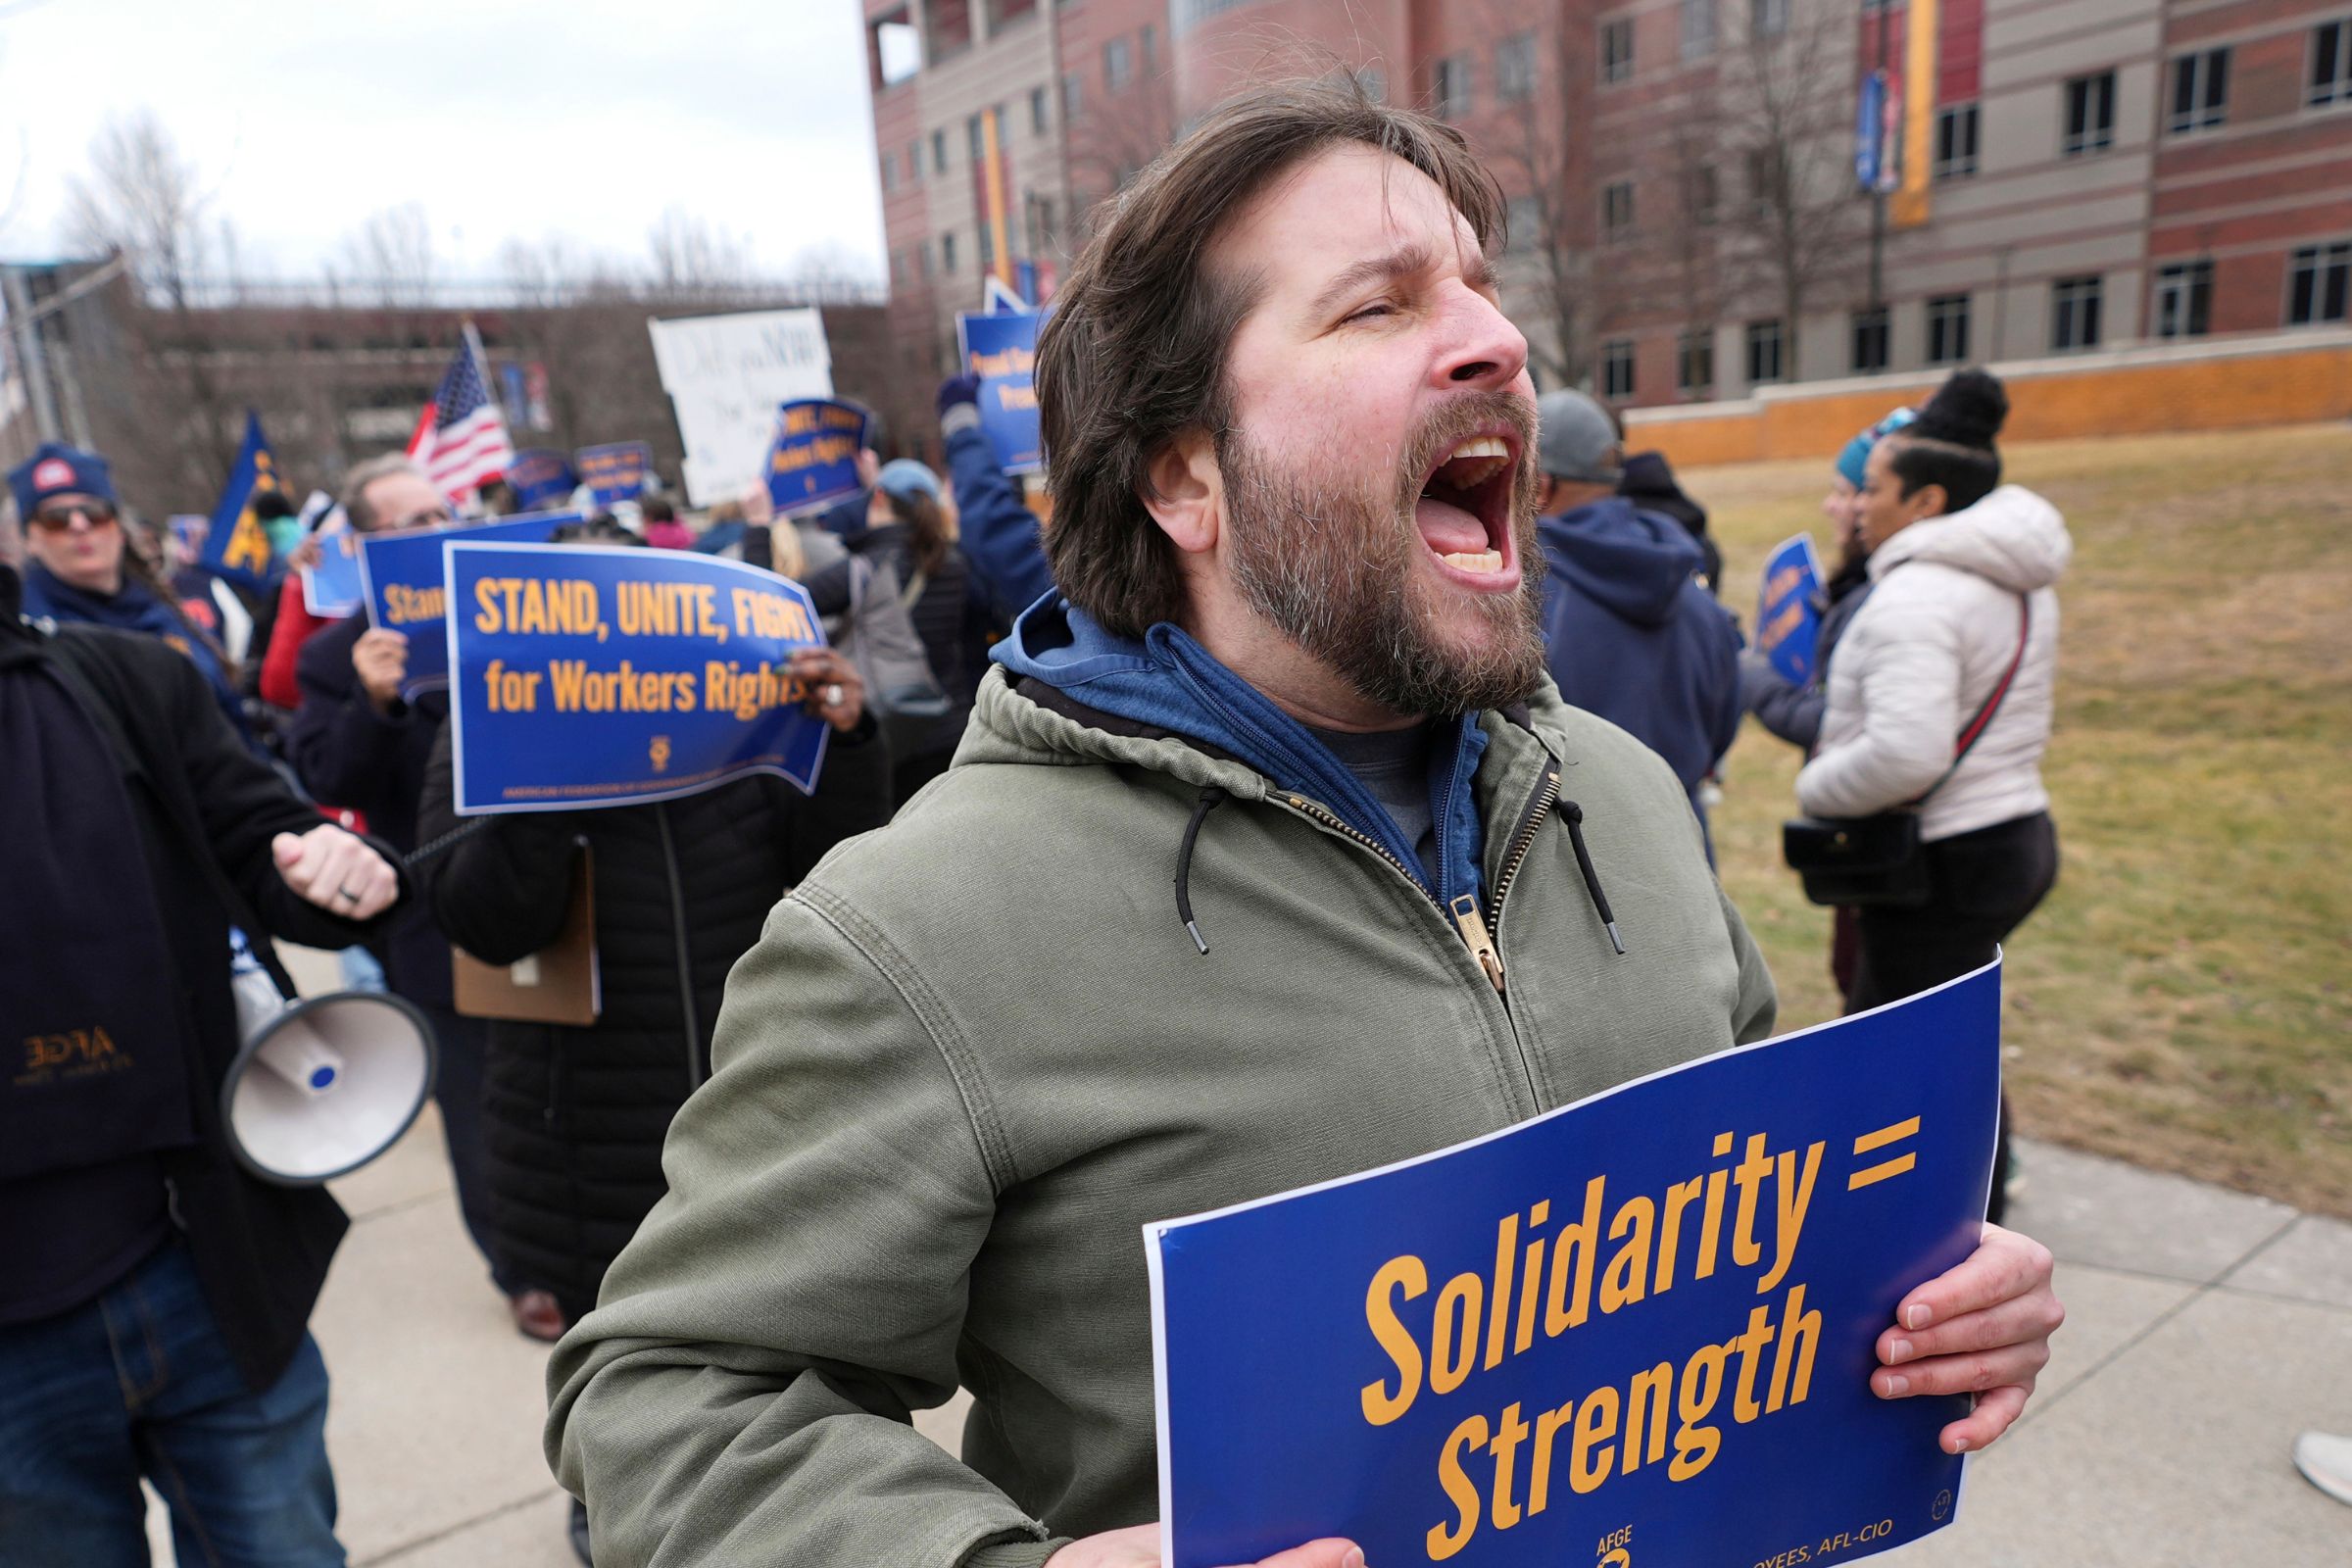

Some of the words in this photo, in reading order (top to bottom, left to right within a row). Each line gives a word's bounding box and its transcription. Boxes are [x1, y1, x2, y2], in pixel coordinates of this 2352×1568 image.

[474, 578, 610, 643] STAND,
[616, 582, 728, 644] UNITE,
[484, 660, 542, 711] for
[549, 660, 697, 712] Workers
[1361, 1130, 1827, 1426] Solidarity
[1847, 1115, 1921, 1191] =
[1426, 1283, 1823, 1561] Strength
[1596, 1524, 1633, 1557] AFGE
[1817, 1519, 1892, 1555] AFL-CIO
